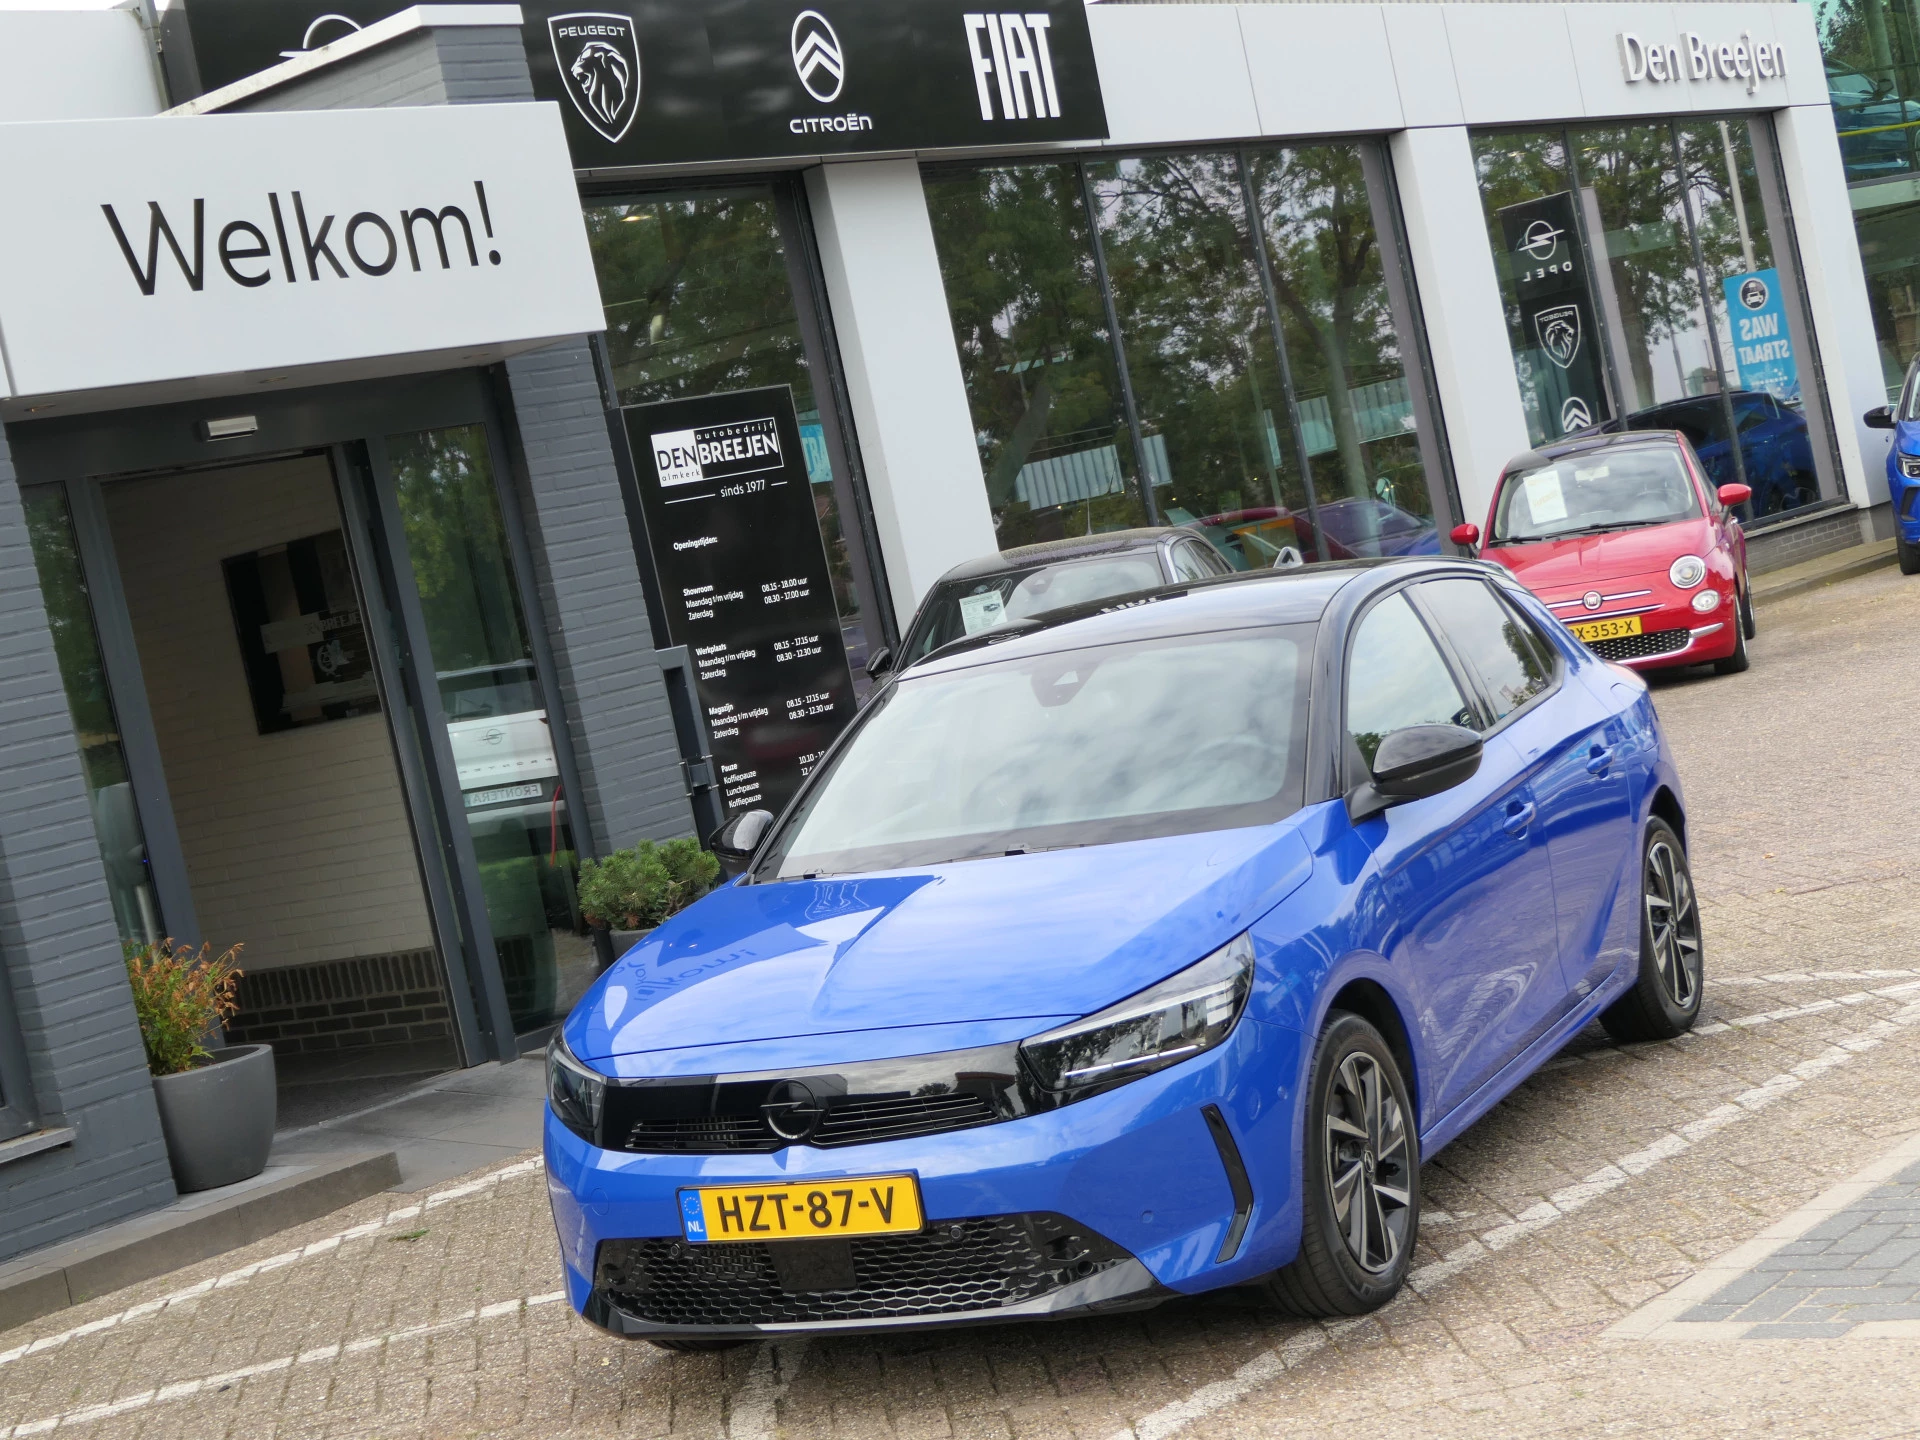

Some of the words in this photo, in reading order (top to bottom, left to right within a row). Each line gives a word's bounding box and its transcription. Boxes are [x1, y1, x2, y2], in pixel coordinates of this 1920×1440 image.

[558, 25, 626, 38] PEUGEOT
[963, 13, 1061, 121] FIAT
[1616, 31, 1682, 84] Den
[1680, 29, 1787, 94] Breejen
[789, 113, 873, 134] CITROËN
[100, 180, 502, 296] Welkom!
[696, 421, 773, 440] autobedrijf
[656, 445, 699, 471] DEN
[698, 432, 779, 465] BREEJEN
[661, 470, 701, 482] almkerk
[720, 485, 745, 498] sinds
[746, 480, 766, 493] 1977
[683, 584, 714, 597] Showroom
[685, 596, 713, 609] Maandag
[723, 590, 744, 602] vrijdag
[761, 582, 777, 593] 08.15
[781, 578, 797, 589] 18.00
[798, 577, 808, 585] uur
[688, 609, 714, 621] Zaterdag
[764, 593, 780, 605] 08.30
[799, 588, 810, 597] uur
[695, 643, 727, 657] Werkplaats
[698, 654, 726, 668] Maandag
[735, 649, 756, 660] vrijdag
[773, 640, 790, 651] 08.15
[794, 636, 808, 646] 17.15
[808, 634, 819, 643] uur
[700, 668, 726, 680] Zaterdag
[776, 652, 793, 663] 08.30
[797, 647, 811, 658] 12.30
[811, 646, 822, 654] uur
[708, 703, 734, 716] Magazijn
[710, 714, 738, 727] Maandag
[748, 707, 769, 719] vrijdag
[786, 698, 802, 709] 08.15
[805, 694, 819, 704] 17.15
[819, 692, 830, 700] uur
[713, 727, 739, 739] Zaterdag
[788, 709, 805, 720] 08.30
[809, 704, 824, 716] 12.30
[824, 703, 834, 711] uur
[721, 763, 738, 773] Pauze
[723, 770, 757, 785] Koffiepauze
[726, 782, 759, 797] Lunchpauze
[728, 793, 762, 809] Koffiepauze
[716, 1185, 894, 1233] HZT-87-V
[687, 1220, 704, 1233] NL
